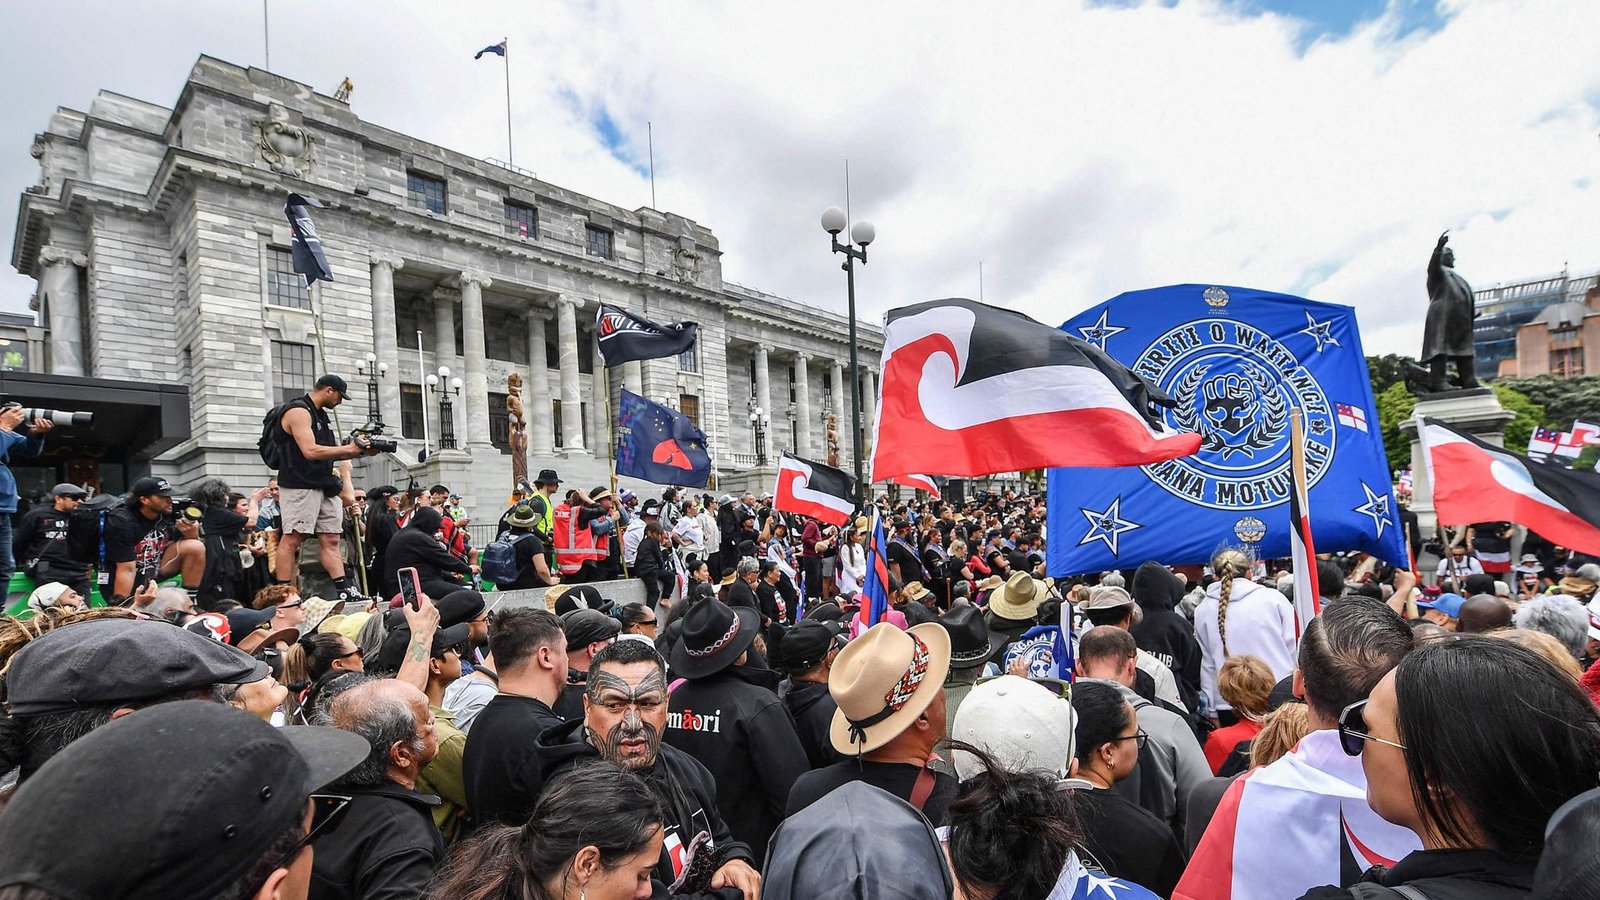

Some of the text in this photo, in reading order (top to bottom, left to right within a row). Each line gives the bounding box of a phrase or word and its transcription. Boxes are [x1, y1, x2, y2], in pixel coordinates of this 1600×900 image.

[1136, 326, 1202, 384] IRITI
[1209, 323, 1225, 343] O
[667, 709, 721, 733] māori
